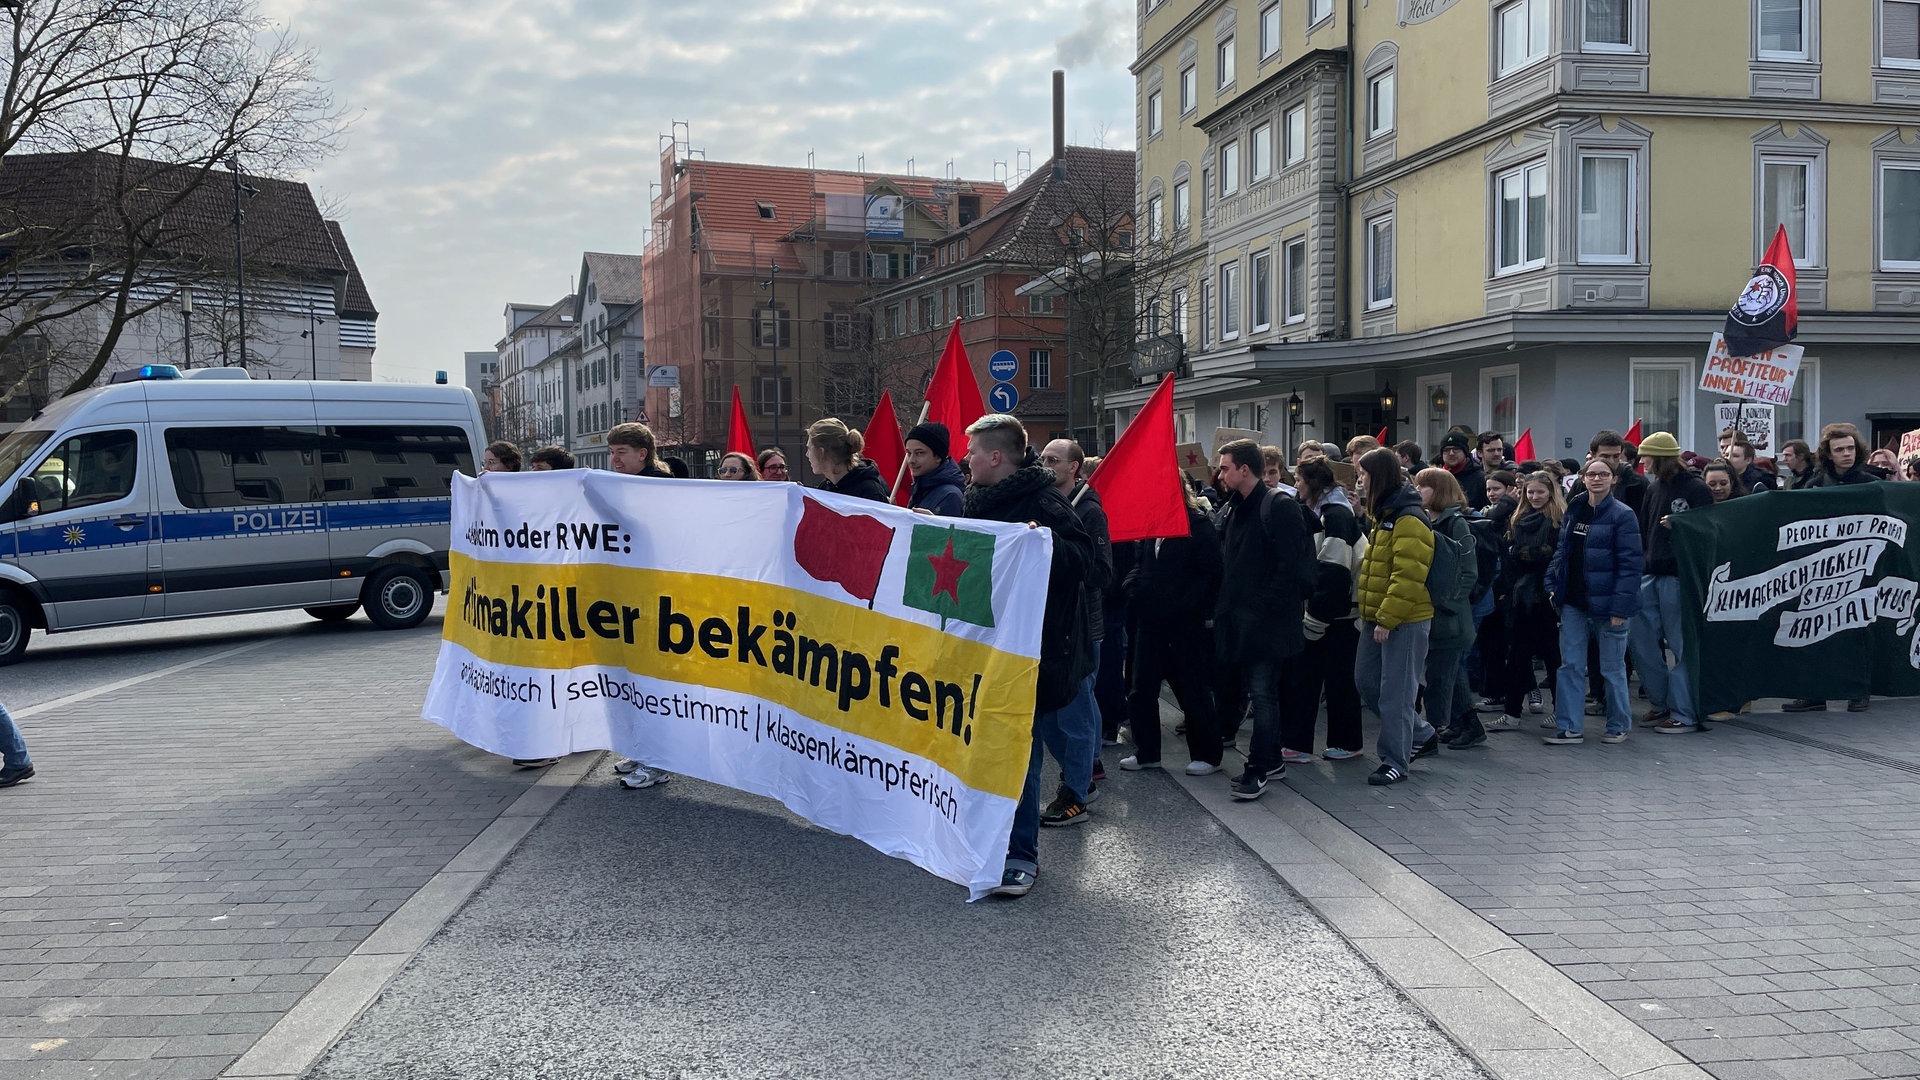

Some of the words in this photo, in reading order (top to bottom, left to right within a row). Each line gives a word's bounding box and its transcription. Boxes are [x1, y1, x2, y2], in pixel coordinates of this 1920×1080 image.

[233, 510, 322, 531] POLIZEI
[1787, 524, 1829, 544] PEOPLE
[1837, 520, 1863, 537] NOT
[504, 522, 551, 549] oder
[557, 523, 631, 554] RWE:
[1804, 580, 1853, 605] STATT
[657, 596, 983, 746] bekämpfen!
[767, 710, 958, 823] klassenkämpferisch
